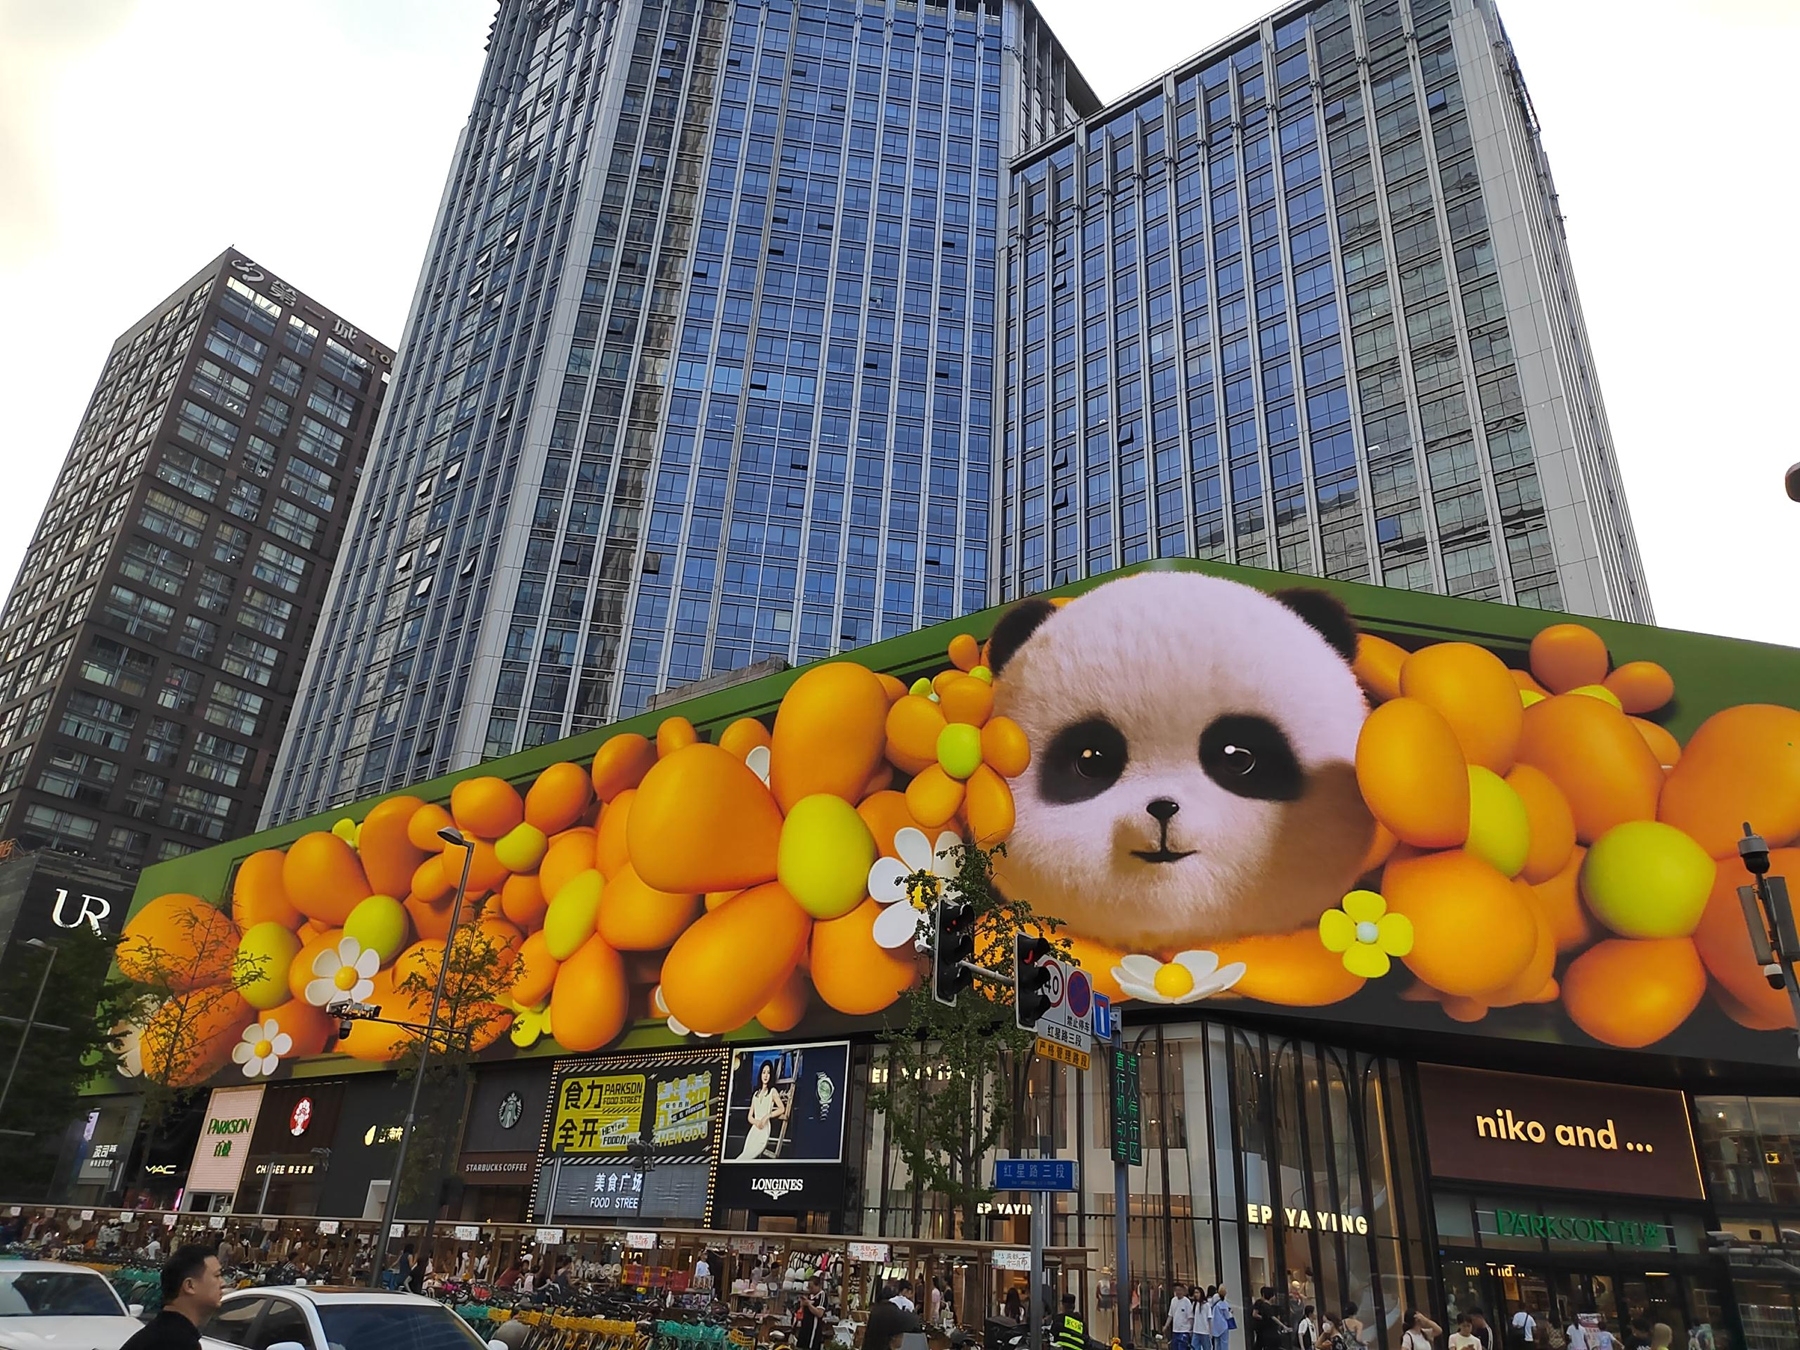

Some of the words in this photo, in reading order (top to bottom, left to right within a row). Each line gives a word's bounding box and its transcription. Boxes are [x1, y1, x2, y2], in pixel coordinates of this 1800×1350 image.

[52, 888, 110, 941] UR
[1043, 976, 1059, 995] 40
[1066, 1015, 1090, 1032] 禁止停车
[1047, 1024, 1082, 1048] 红星路三段
[1039, 1041, 1087, 1067] 严格管理路段
[565, 1080, 604, 1110] 食力
[604, 1082, 643, 1095] PARKSON
[602, 1096, 619, 1105] FOOD
[620, 1095, 641, 1104] STREET
[1115, 1050, 1127, 1160] 直行机动车
[1127, 1055, 1140, 1162] 进入待行区
[206, 1118, 252, 1135] PARKSON
[558, 1118, 599, 1148] 全开
[1476, 1108, 1546, 1144] niko
[1555, 1119, 1618, 1150] and
[465, 1163, 502, 1172] STARBUCKS
[503, 1163, 528, 1172] COFFEE
[1003, 1163, 1065, 1179] 红星路三段
[594, 1172, 642, 1192] 美食广场
[751, 1178, 804, 1191] LONGINES
[590, 1197, 610, 1208] FOOD
[615, 1197, 640, 1209] STREE
[976, 1203, 992, 1214] EP
[1247, 1203, 1273, 1224] EP
[1495, 1208, 1613, 1242] PARKSON
